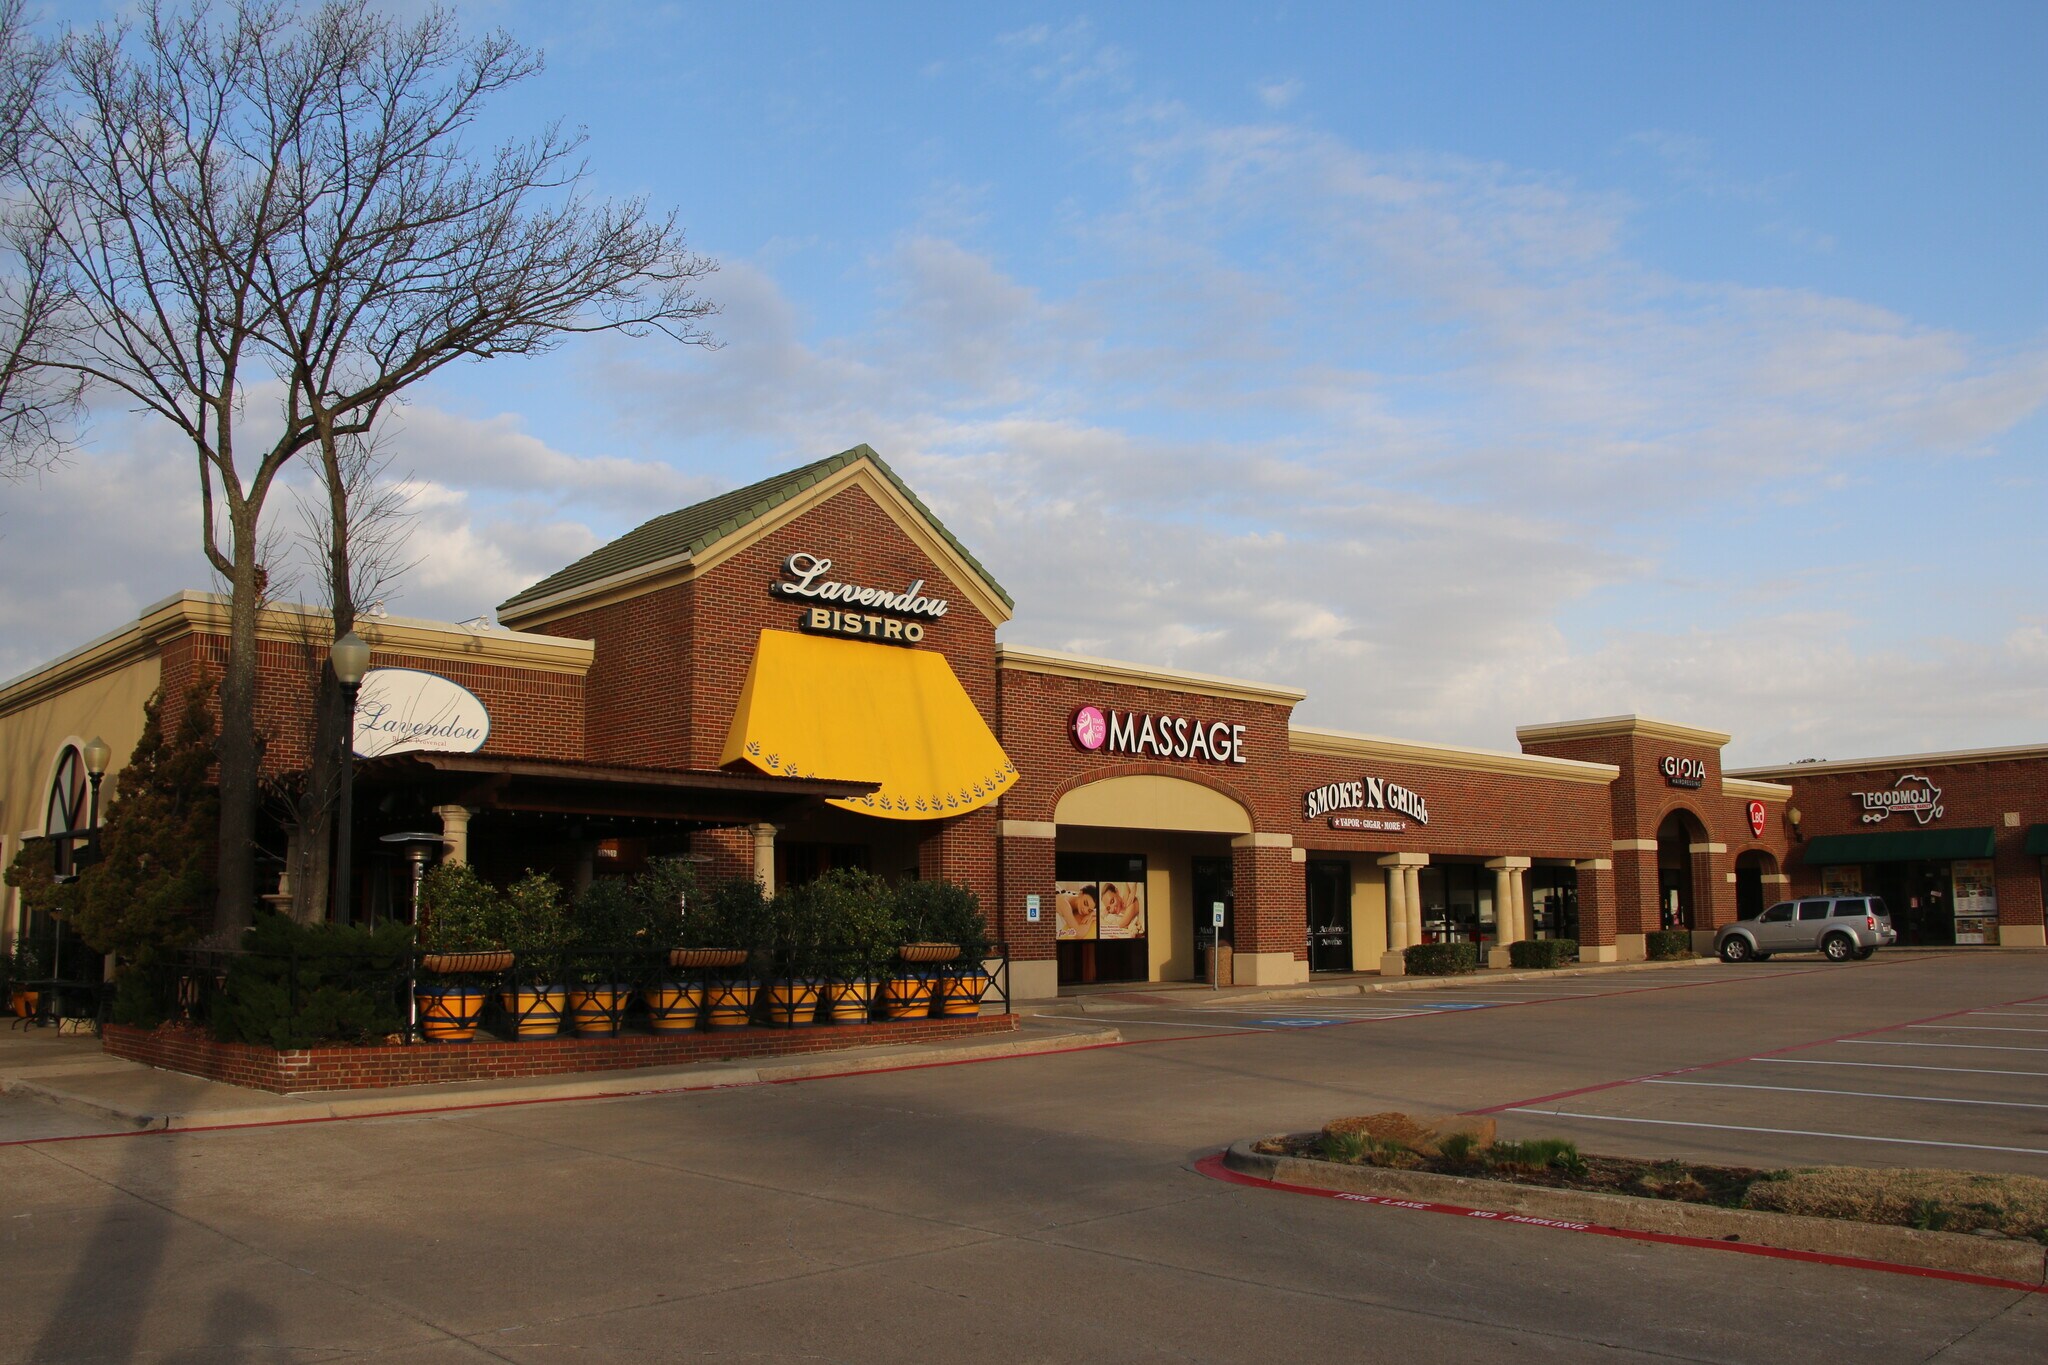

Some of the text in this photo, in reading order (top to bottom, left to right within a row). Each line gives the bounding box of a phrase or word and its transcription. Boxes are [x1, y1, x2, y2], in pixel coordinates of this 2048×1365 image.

[782, 553, 948, 617] Lavendou
[811, 608, 924, 642] BISTRO
[358, 701, 480, 740] Lavendou
[1092, 717, 1104, 726] TIME
[1093, 724, 1104, 732] FOR
[1109, 710, 1247, 763] MASSAGE
[1665, 756, 1706, 779] GIOIA
[1308, 776, 1428, 825] SMOKE N CHILL
[1867, 788, 1931, 806] FOODMOJI
[1340, 817, 1401, 831] VAPOR CIGAR MORE
[1334, 1192, 1432, 1210] FIRE LANE
[1467, 1210, 1589, 1230] NO PARKING
